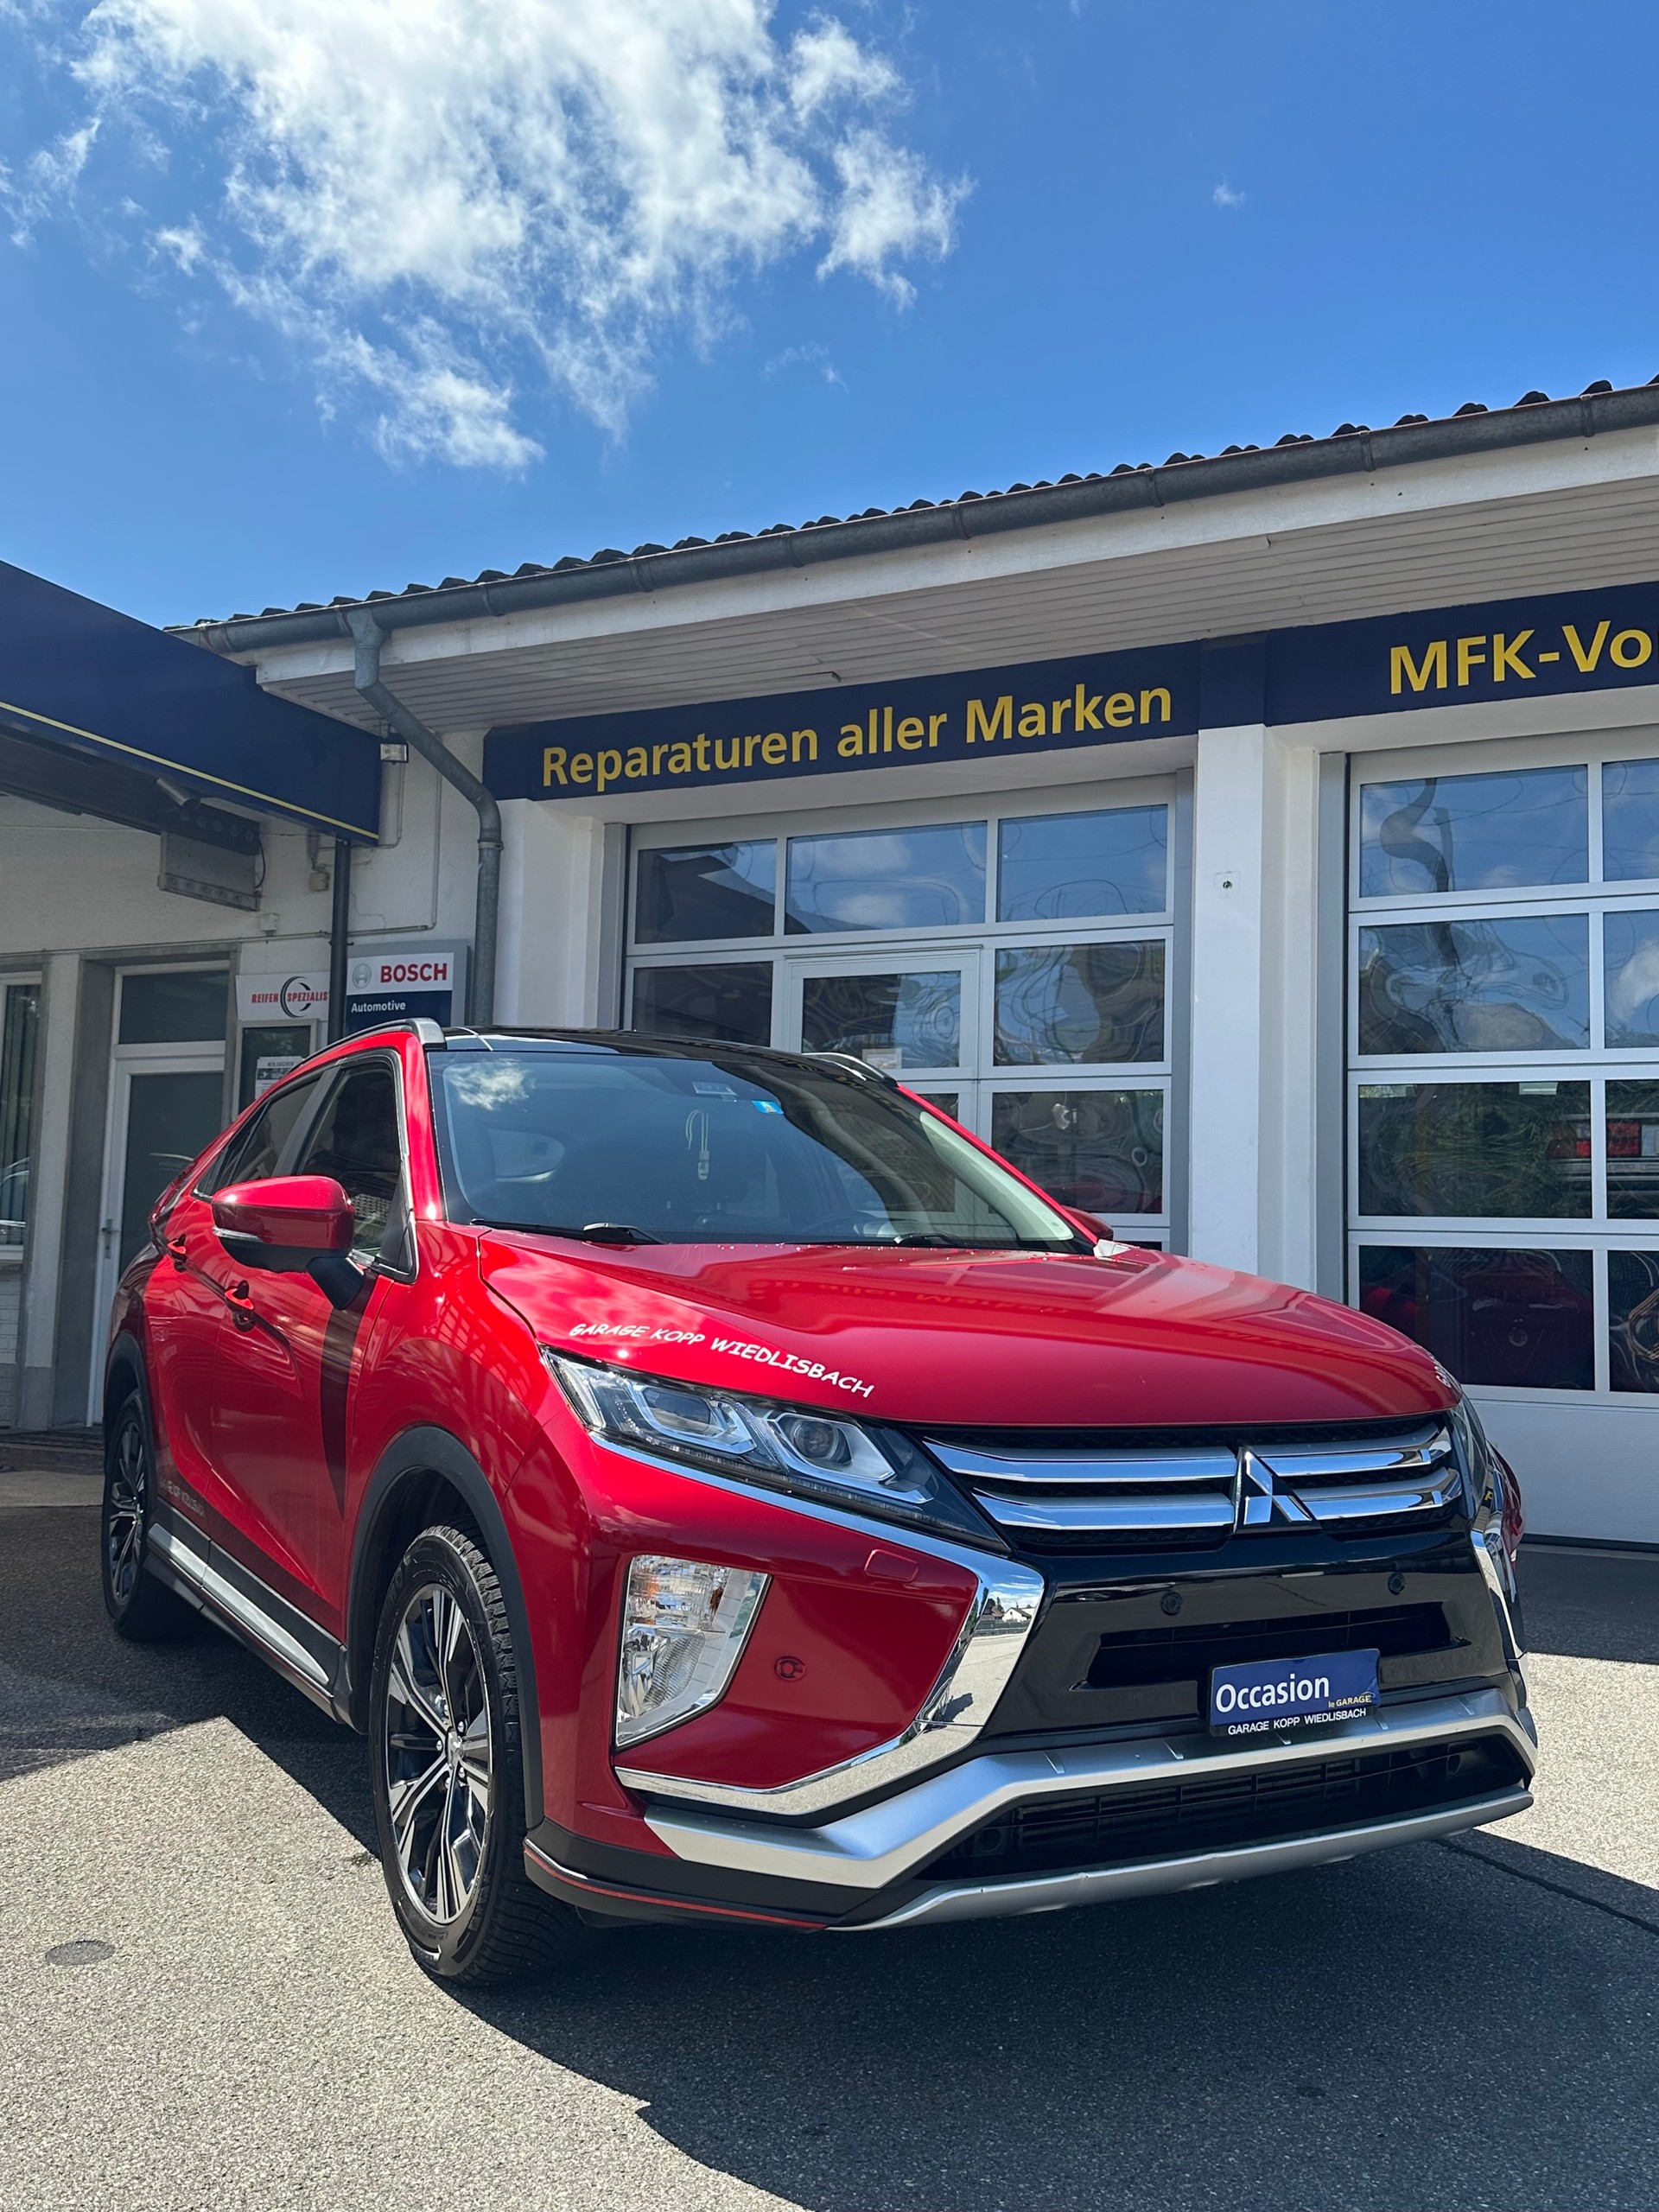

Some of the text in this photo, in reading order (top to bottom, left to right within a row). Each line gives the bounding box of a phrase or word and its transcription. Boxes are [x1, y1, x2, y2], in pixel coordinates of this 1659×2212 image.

[1390, 620, 1652, 695] MFK-Vo
[543, 683, 1171, 791] Reparaturen aller Marken
[380, 963, 448, 983] BOSCH
[251, 991, 329, 1003] REIFEN SPEZIALIS
[351, 1000, 406, 1013] Automotive
[569, 1323, 874, 1398] GARAGE KOPP WIEDLISBACH
[1215, 1673, 1330, 1713] Occasion
[1336, 1694, 1372, 1707] GARAGE
[1228, 1707, 1366, 1736] GARAGE KOPP WIEDLISBACH
